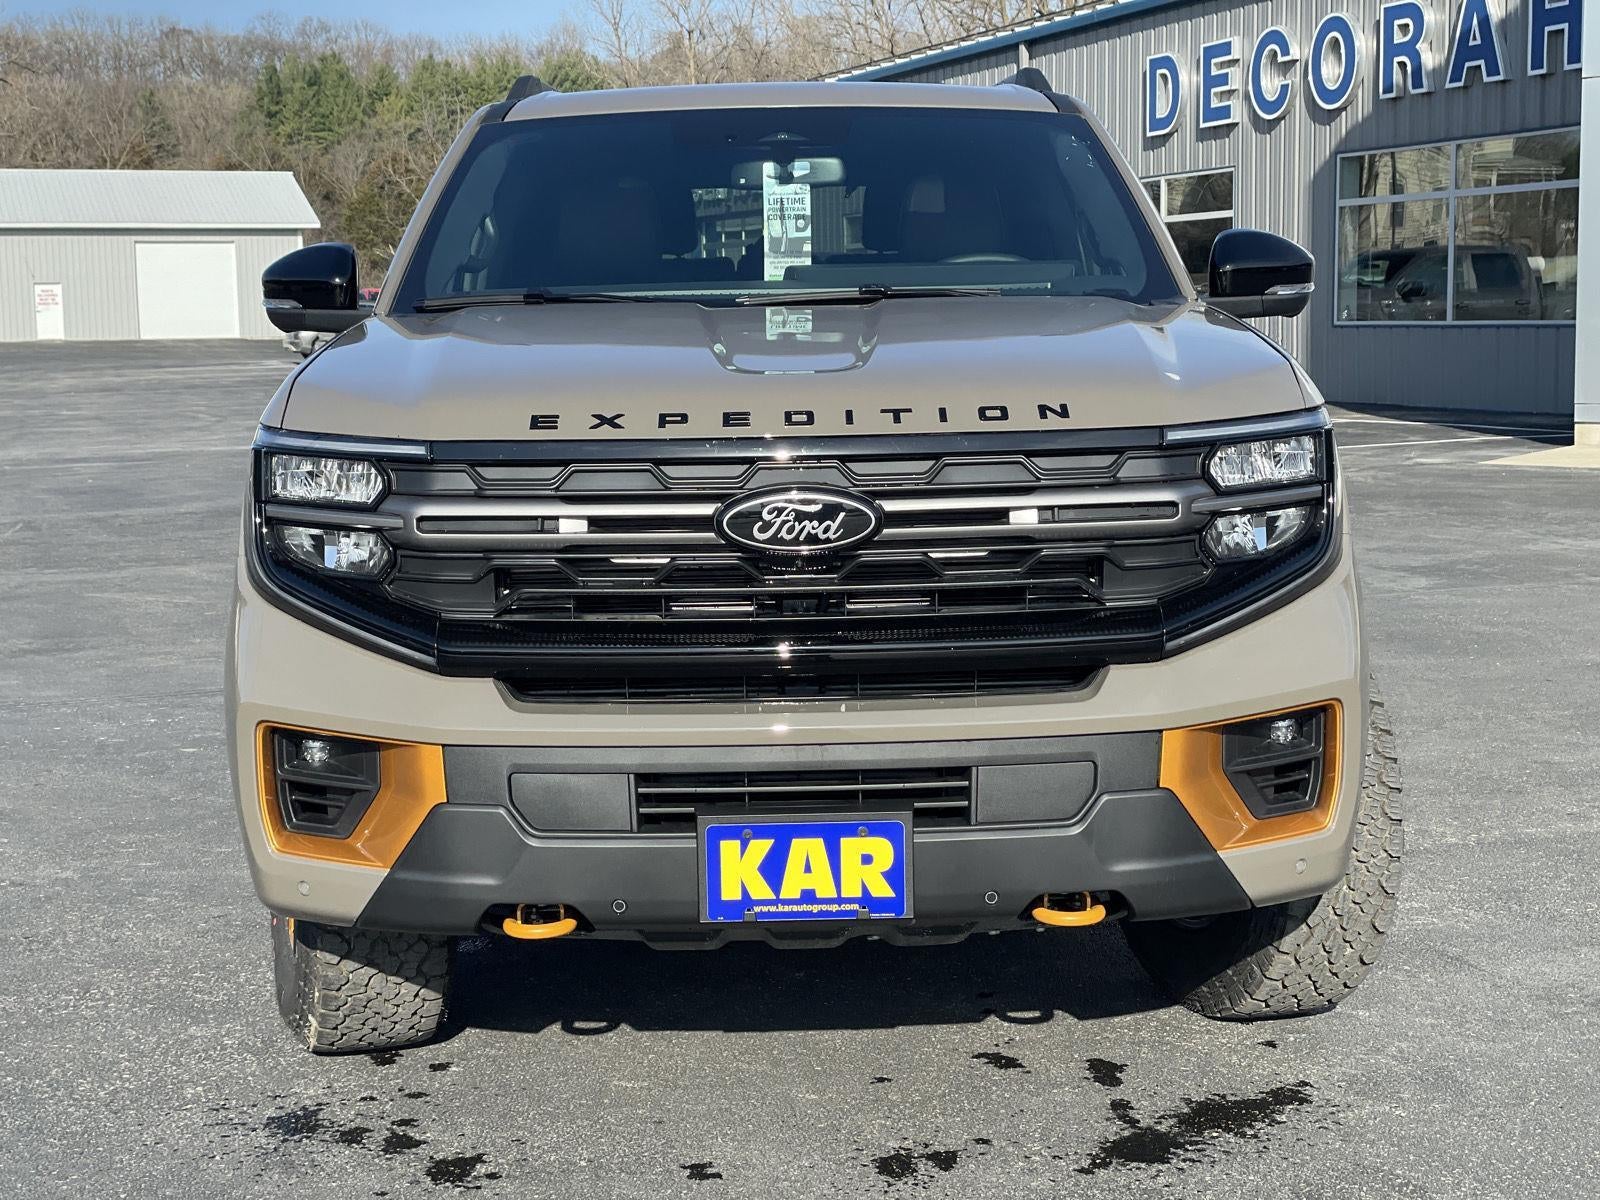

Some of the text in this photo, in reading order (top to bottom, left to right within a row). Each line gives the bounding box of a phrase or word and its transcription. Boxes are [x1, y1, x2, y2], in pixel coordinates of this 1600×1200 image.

[1146, 0, 1582, 137] DECORAH
[767, 197, 806, 206] LIFETIME
[767, 213, 806, 221] COVERAGE
[529, 403, 1071, 430] EXPEDITION
[752, 502, 846, 542] Ford
[719, 836, 896, 901] KAR
[753, 903, 859, 913] www.karautogroup.com
